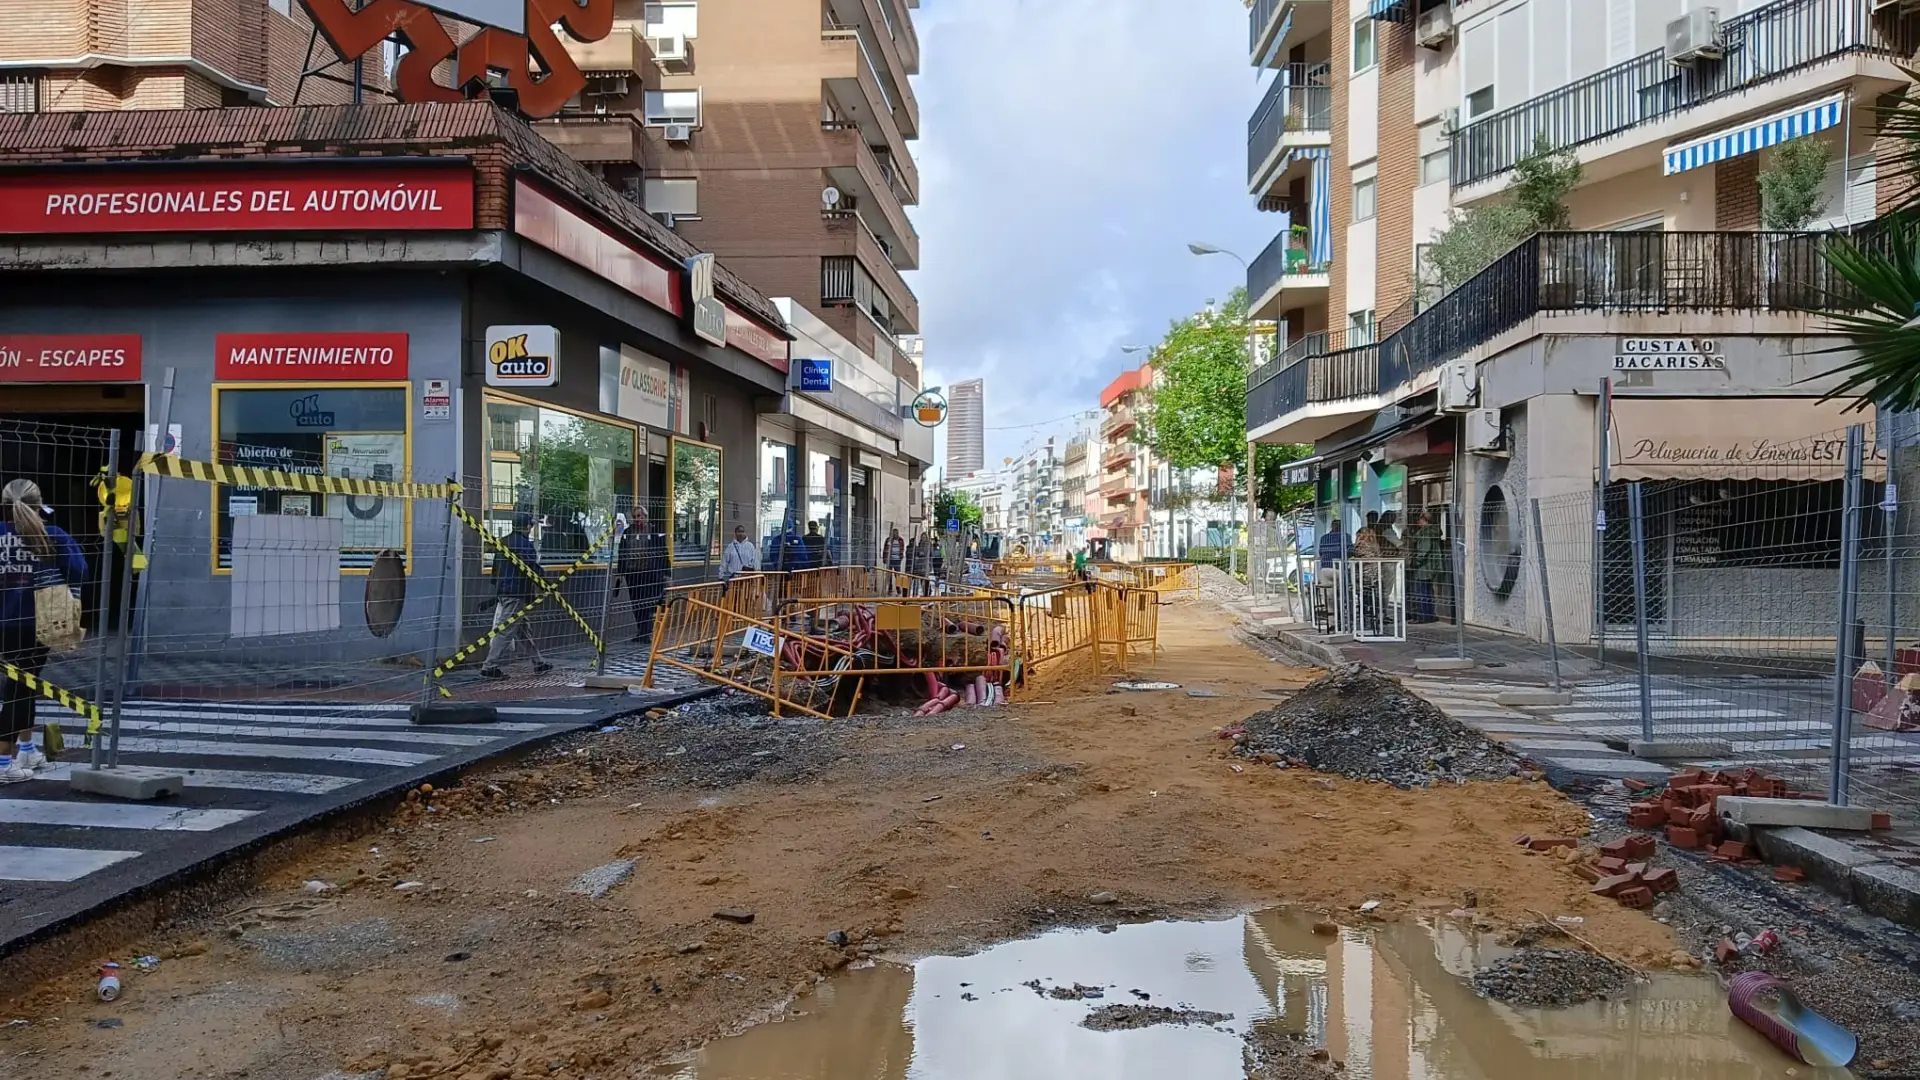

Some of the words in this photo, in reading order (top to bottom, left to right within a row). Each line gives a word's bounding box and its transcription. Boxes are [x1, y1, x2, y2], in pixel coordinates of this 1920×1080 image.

[46, 191, 243, 215] PROFESIONALES
[250, 190, 295, 212] DEL
[303, 183, 443, 211] AUTOMÓVIL
[489, 333, 529, 365] OK
[1625, 340, 1713, 352] GUSTAVO
[39, 349, 125, 367] ESCAPES
[230, 347, 394, 365] MANTENIMIENTO
[1614, 356, 1725, 369] BACARISAS
[499, 358, 546, 374] auto
[803, 377, 829, 386] Dental
[290, 394, 320, 419] OK
[299, 412, 333, 426] auto
[237, 446, 277, 458] Abierto
[279, 447, 293, 458] de
[1726, 443, 1744, 460] de
